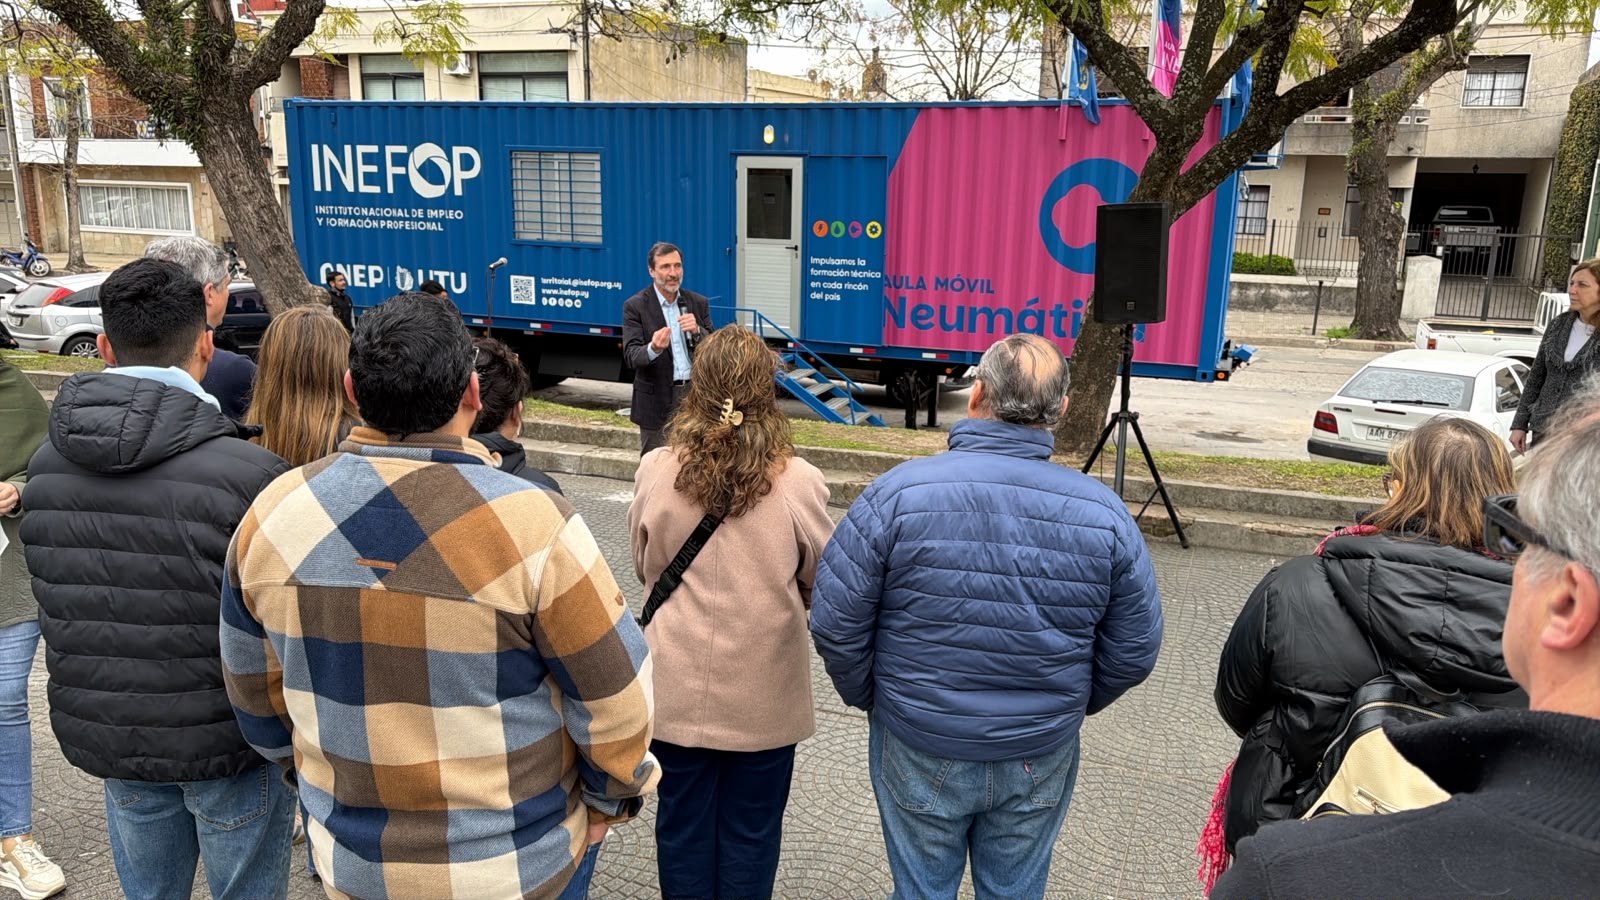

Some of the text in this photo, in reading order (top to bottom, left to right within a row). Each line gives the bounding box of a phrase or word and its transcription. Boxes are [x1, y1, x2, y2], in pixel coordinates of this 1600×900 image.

[311, 142, 481, 198] INEFOP
[315, 205, 464, 220] INSTITUTO NACIONAL DE EMPLEO
[316, 217, 444, 232] Y FORMACIÓN PROFESIONAL
[810, 256, 866, 266] Impulsamos la
[810, 268, 881, 278] formación técnica
[822, 281, 843, 289] cada
[844, 282, 869, 290] rincón
[884, 274, 995, 294] AULA MÓVIL
[810, 292, 823, 300] del
[884, 295, 1145, 343] Neumáti
